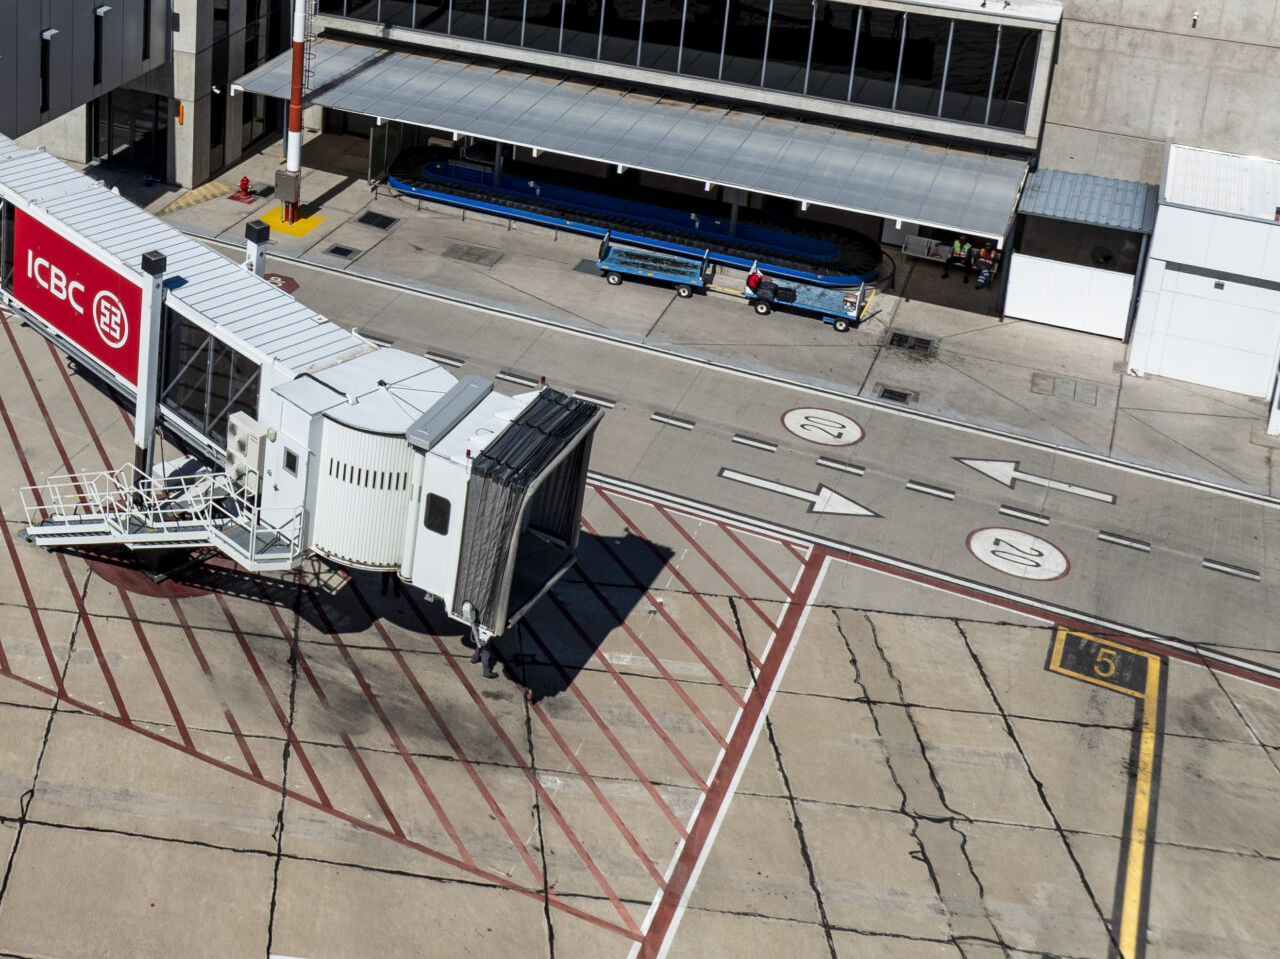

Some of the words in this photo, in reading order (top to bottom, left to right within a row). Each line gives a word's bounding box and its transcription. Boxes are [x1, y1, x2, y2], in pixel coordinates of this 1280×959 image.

[27, 248, 85, 315] ICBC
[800, 415, 847, 440] 20
[990, 537, 1044, 568] 20
[1094, 647, 1117, 678] 5
